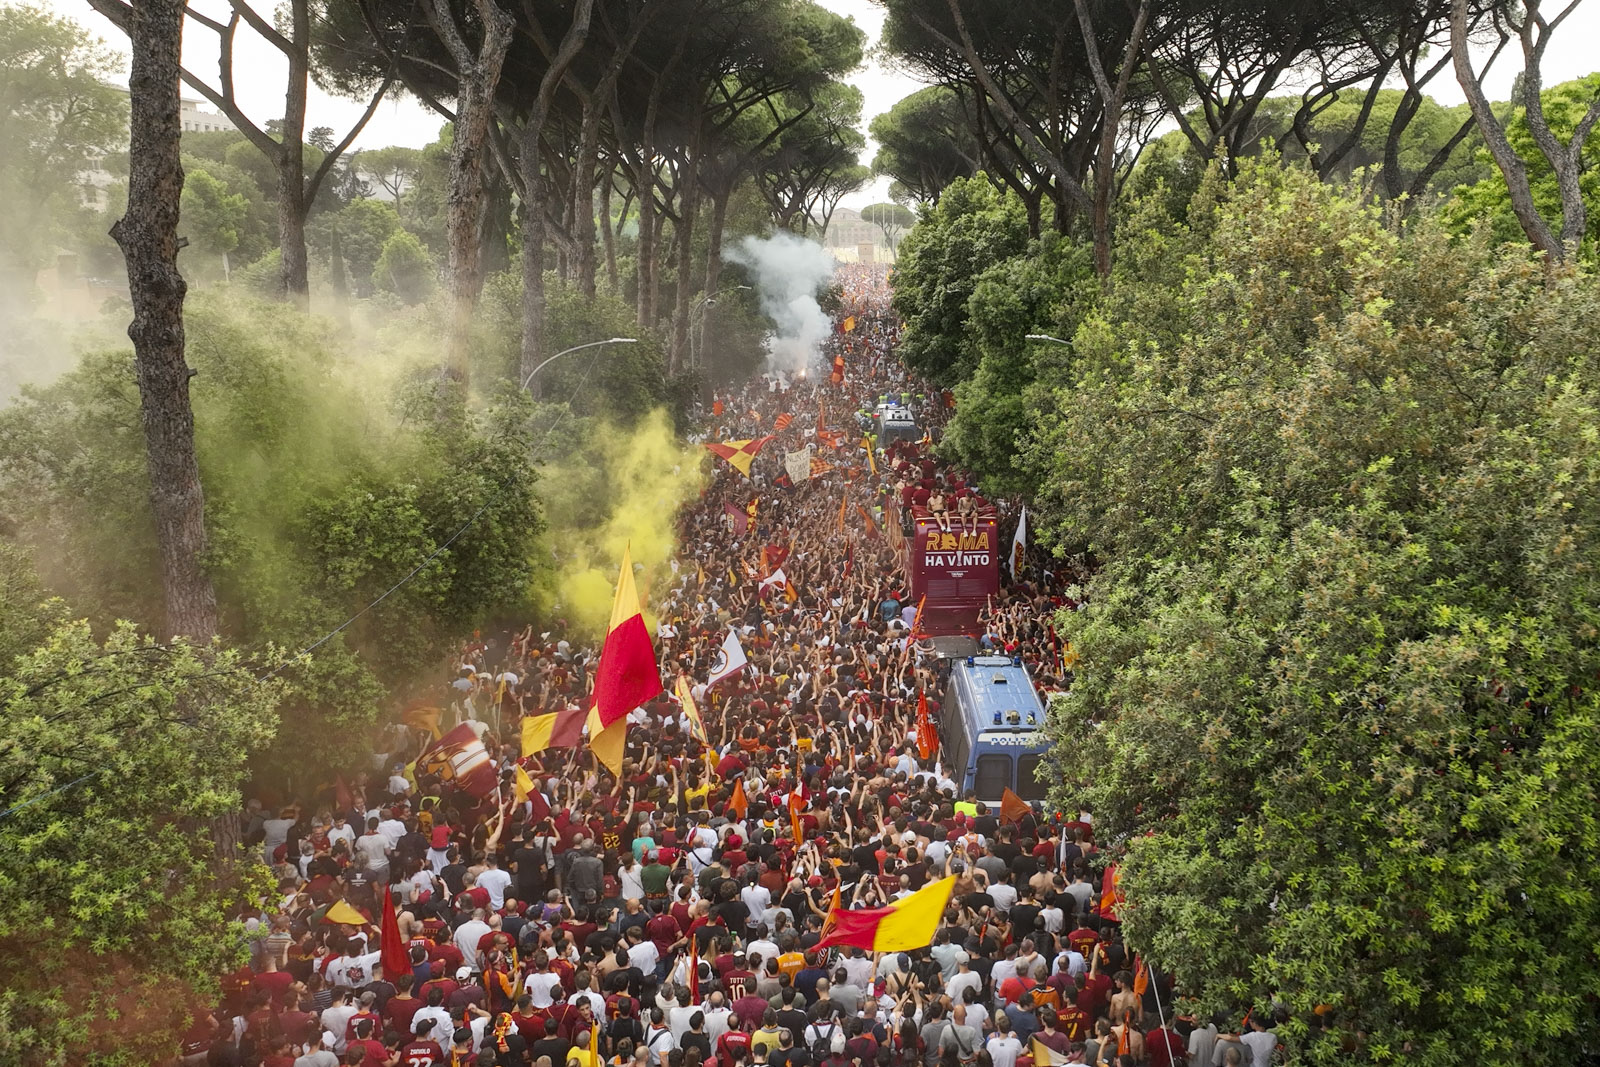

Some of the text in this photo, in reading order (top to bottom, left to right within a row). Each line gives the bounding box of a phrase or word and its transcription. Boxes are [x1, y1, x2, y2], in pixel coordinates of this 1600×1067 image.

[926, 532, 989, 550] RMA
[925, 556, 944, 566] HA
[991, 737, 1030, 746] POLIZ
[730, 984, 746, 1002] 10
